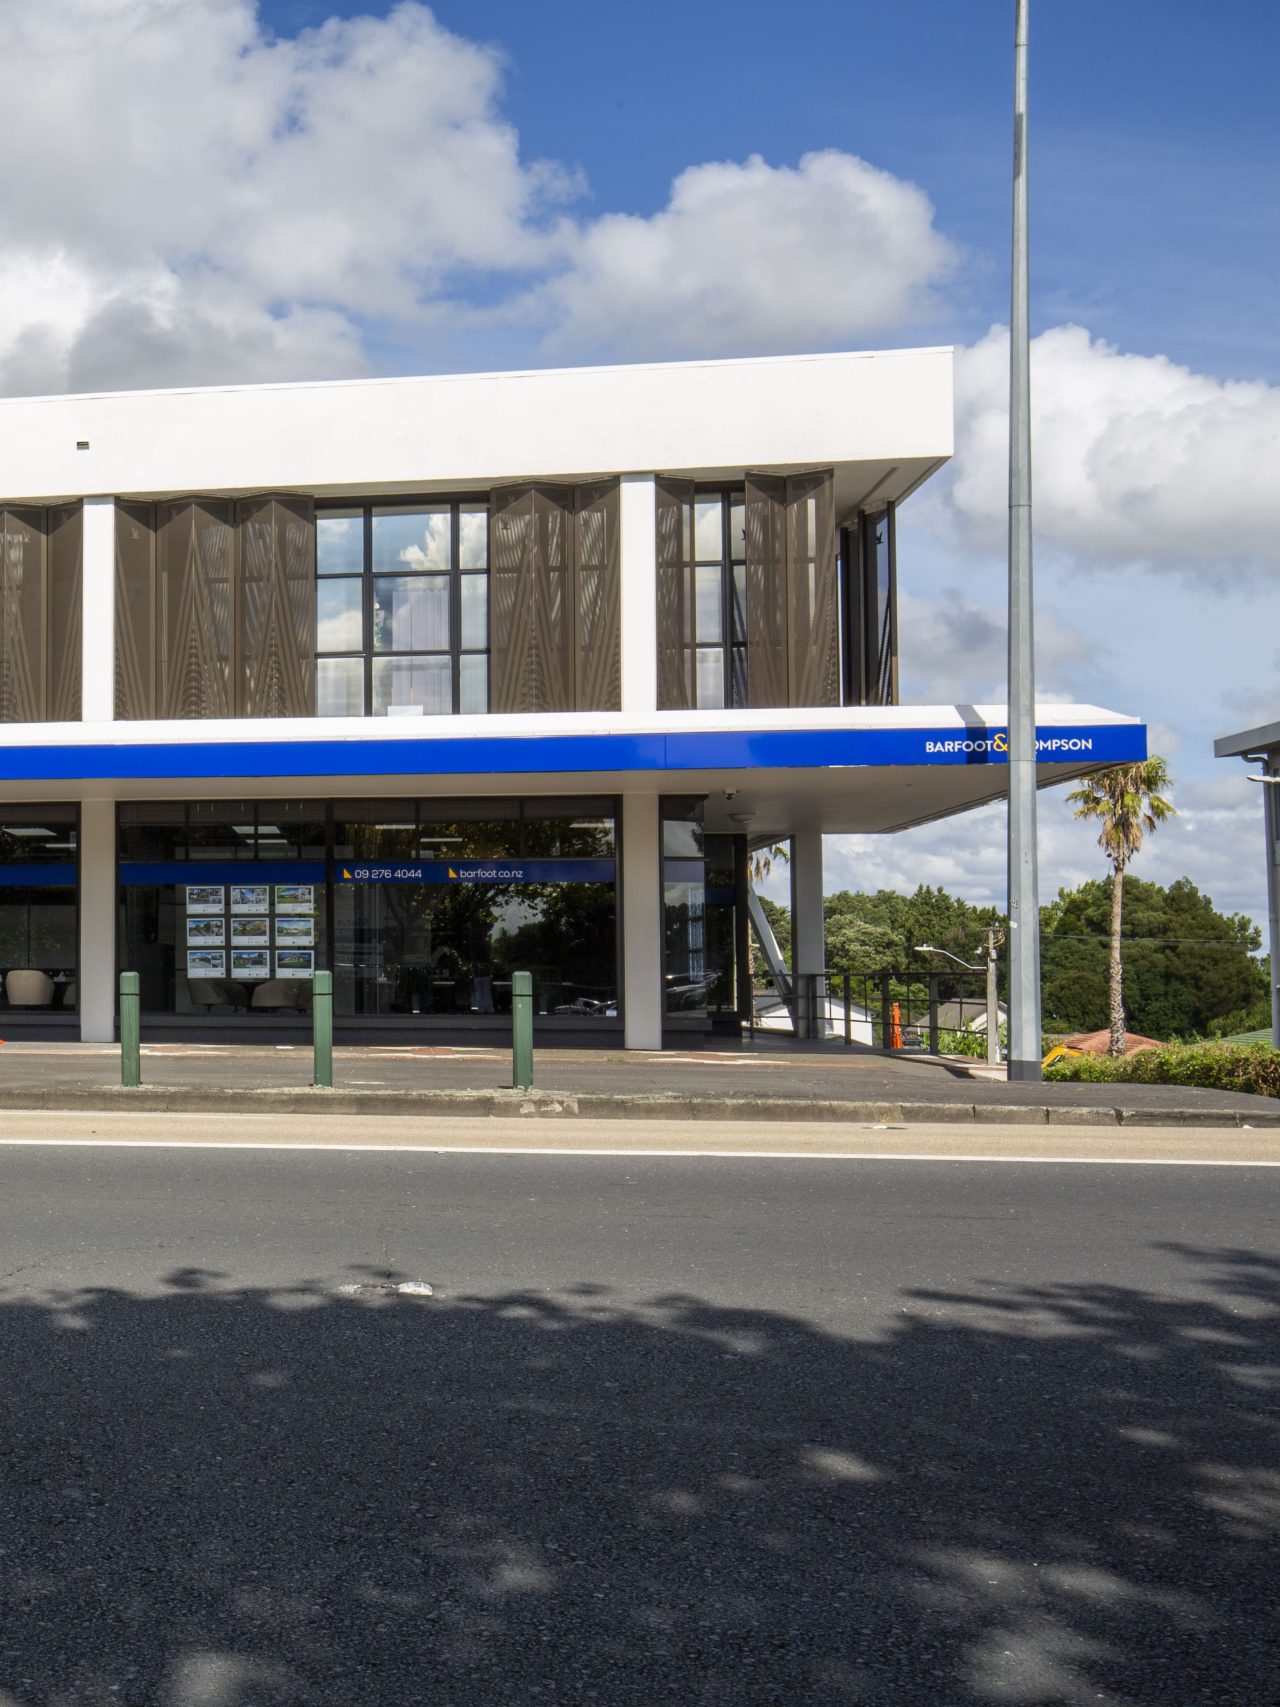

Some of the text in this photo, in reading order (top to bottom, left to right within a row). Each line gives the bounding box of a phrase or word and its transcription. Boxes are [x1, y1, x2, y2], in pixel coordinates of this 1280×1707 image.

[925, 740, 993, 753] BARFOOT
[354, 869, 422, 879] 09 276 4044
